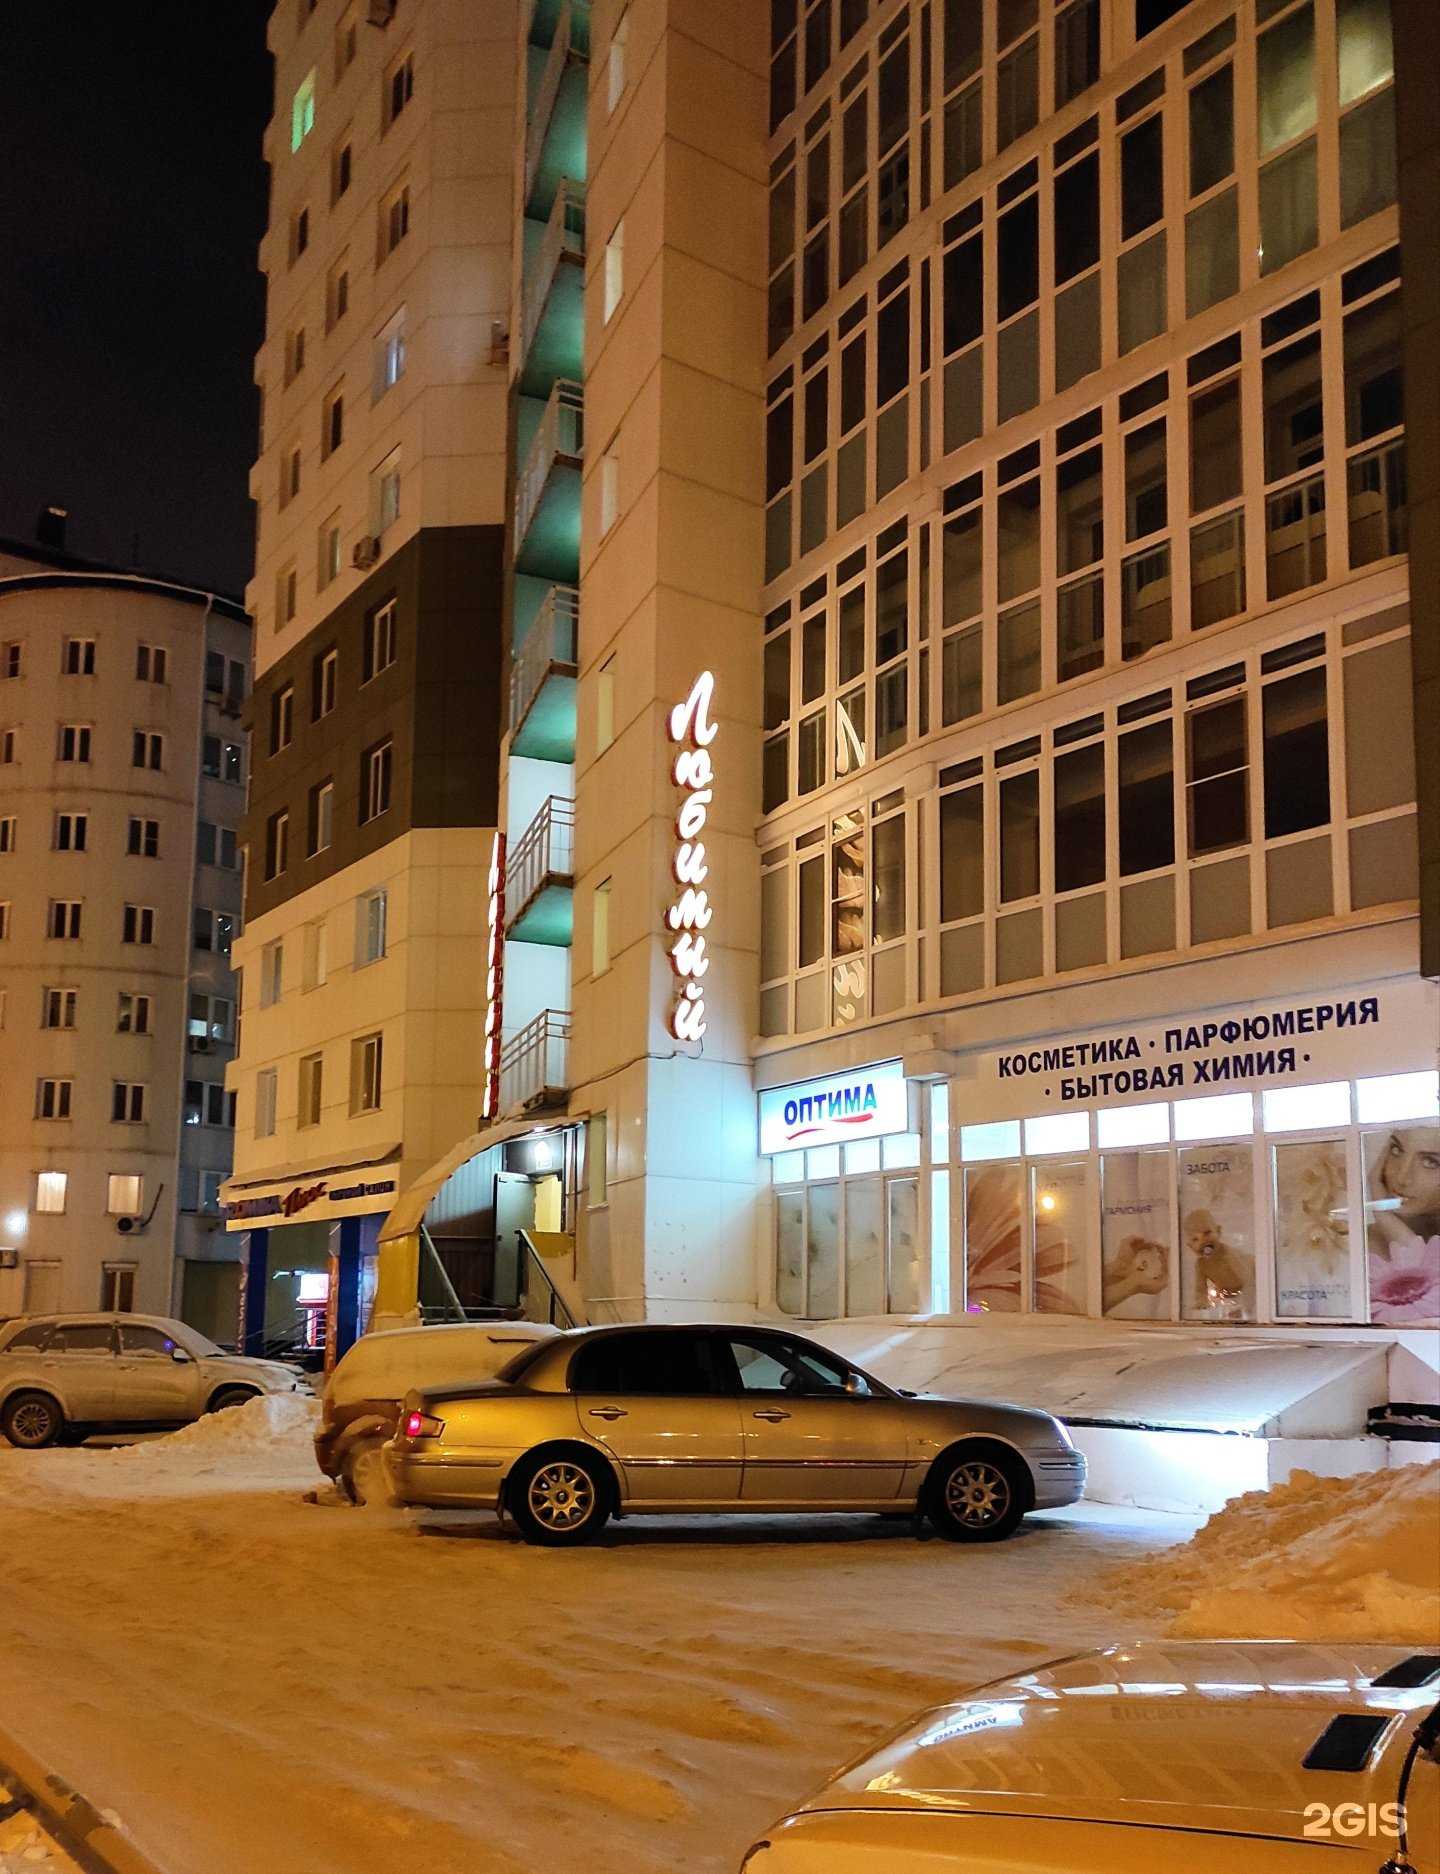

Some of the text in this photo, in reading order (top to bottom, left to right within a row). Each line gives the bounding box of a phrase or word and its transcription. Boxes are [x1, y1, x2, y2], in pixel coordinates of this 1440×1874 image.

[999, 997, 1380, 1078] КОСМЕТИКА ПАРФЮМЕРИЯ
[1060, 1047, 1297, 1101] БЫТОВАЯ ХИМИЯ
[783, 1082, 878, 1127] ОПТИМА
[1185, 1161, 1232, 1176] ЗАБОТА
